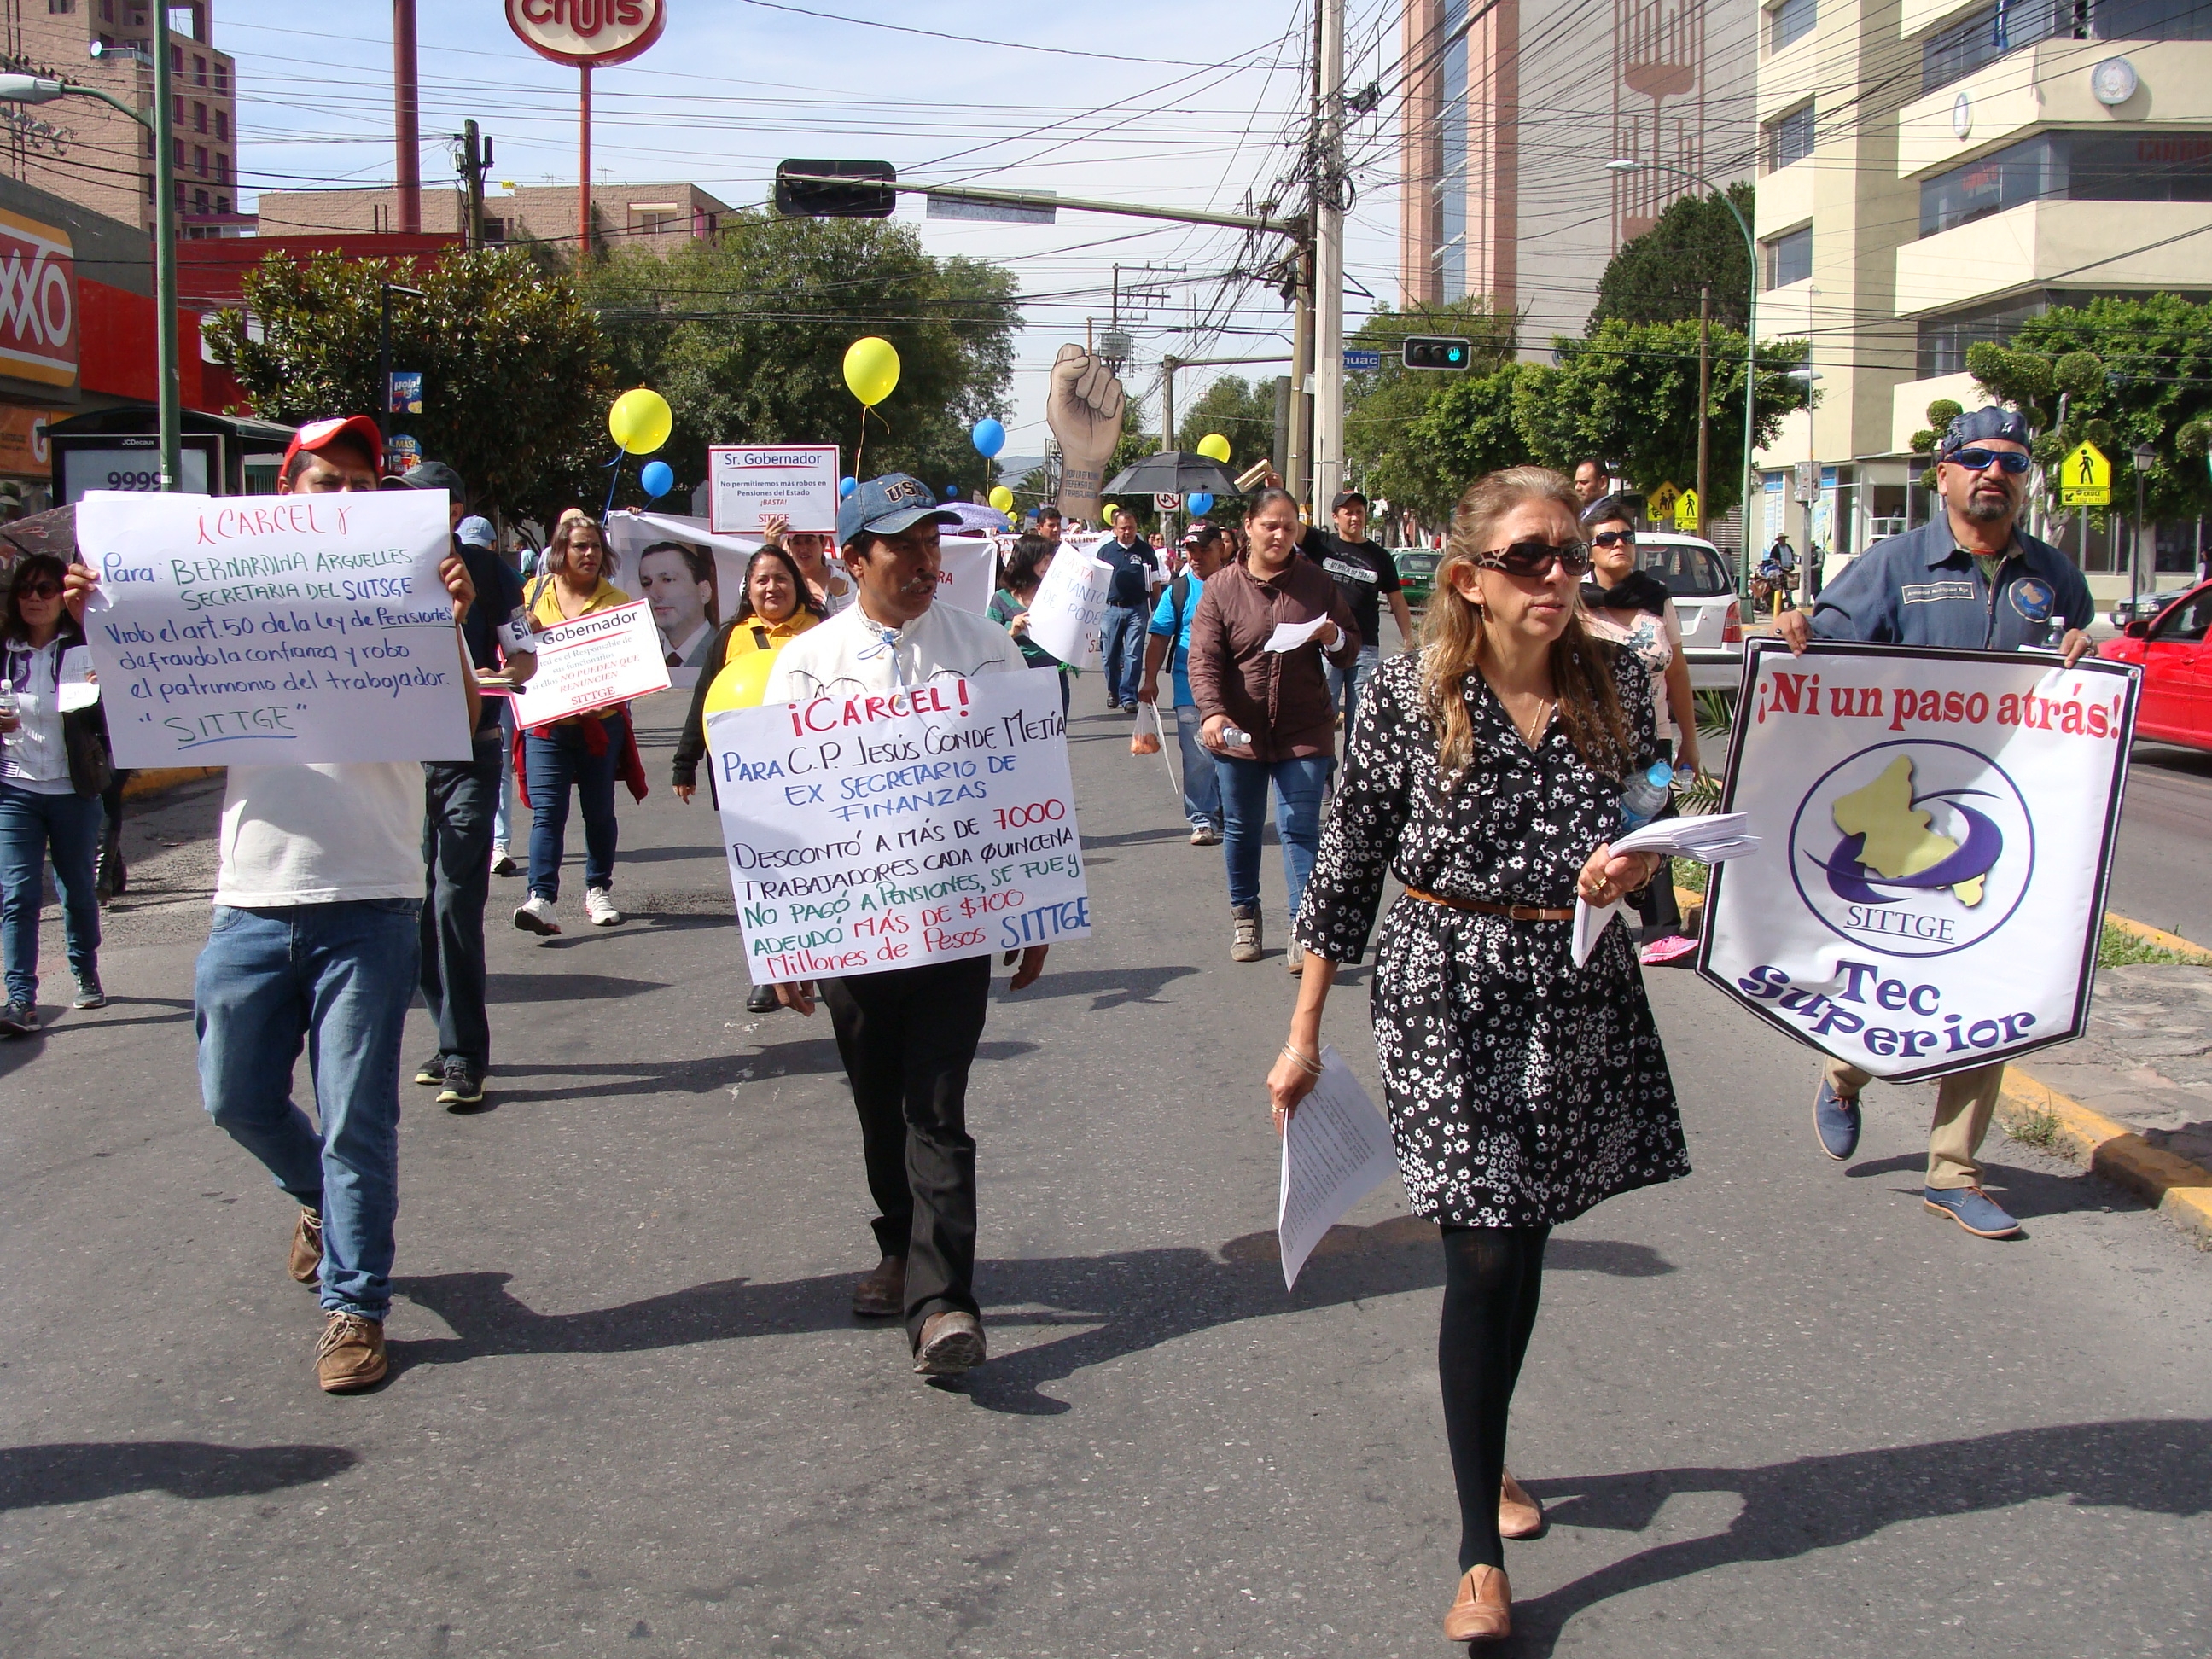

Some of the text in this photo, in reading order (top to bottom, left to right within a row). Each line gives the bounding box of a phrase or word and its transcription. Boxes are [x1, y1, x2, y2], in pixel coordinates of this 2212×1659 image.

[725, 452, 822, 465] Sr. Gobernador
[760, 498, 787, 507] ¡BASTA!
[885, 480, 929, 504] USA
[172, 552, 308, 586] BERNARDINA
[317, 549, 413, 574] ARGUELLES
[181, 583, 298, 611] SECRETARIA
[307, 582, 344, 600] DEL
[1067, 577, 1106, 605] TANTO
[542, 611, 638, 645] Gobernador
[1067, 602, 1101, 626] PODE
[346, 648, 358, 668] y
[362, 637, 410, 660] robo
[552, 652, 614, 674] sus funcionarios
[573, 640, 621, 660] Responsable
[622, 636, 632, 645] de
[283, 669, 318, 690] del
[540, 677, 559, 689] ellos
[560, 672, 576, 682] NO
[576, 661, 618, 679] PUEDEN
[619, 654, 640, 667] QUE
[560, 671, 619, 693] RENUNCIEN
[571, 686, 615, 706] SITTGE
[1758, 671, 2122, 740] ¡Ni un paso atrás!
[853, 733, 920, 767] JESÚS
[924, 725, 996, 756] CONDE
[1004, 708, 1067, 747] MEJÍA
[784, 754, 1017, 807] EX SECRETARIO DE
[829, 780, 987, 822] FINANZAS
[732, 798, 1066, 870] DESCONTÓ A MÁS DE 7000
[737, 826, 1074, 902] TRABAJADORES CADA QUINCENA
[743, 905, 777, 929] NO
[790, 890, 851, 923] PAGÓ
[861, 894, 878, 911] A
[990, 866, 1014, 887] SE
[1020, 858, 1061, 879] FUE
[753, 888, 1024, 957] ADEUDÓ MÁS DE $700
[765, 896, 1091, 980] Millones de Pesos SITTGE
[1846, 905, 1954, 940] SITTGE
[1835, 959, 1940, 1016] Tec
[1738, 964, 2036, 1057] Superior
